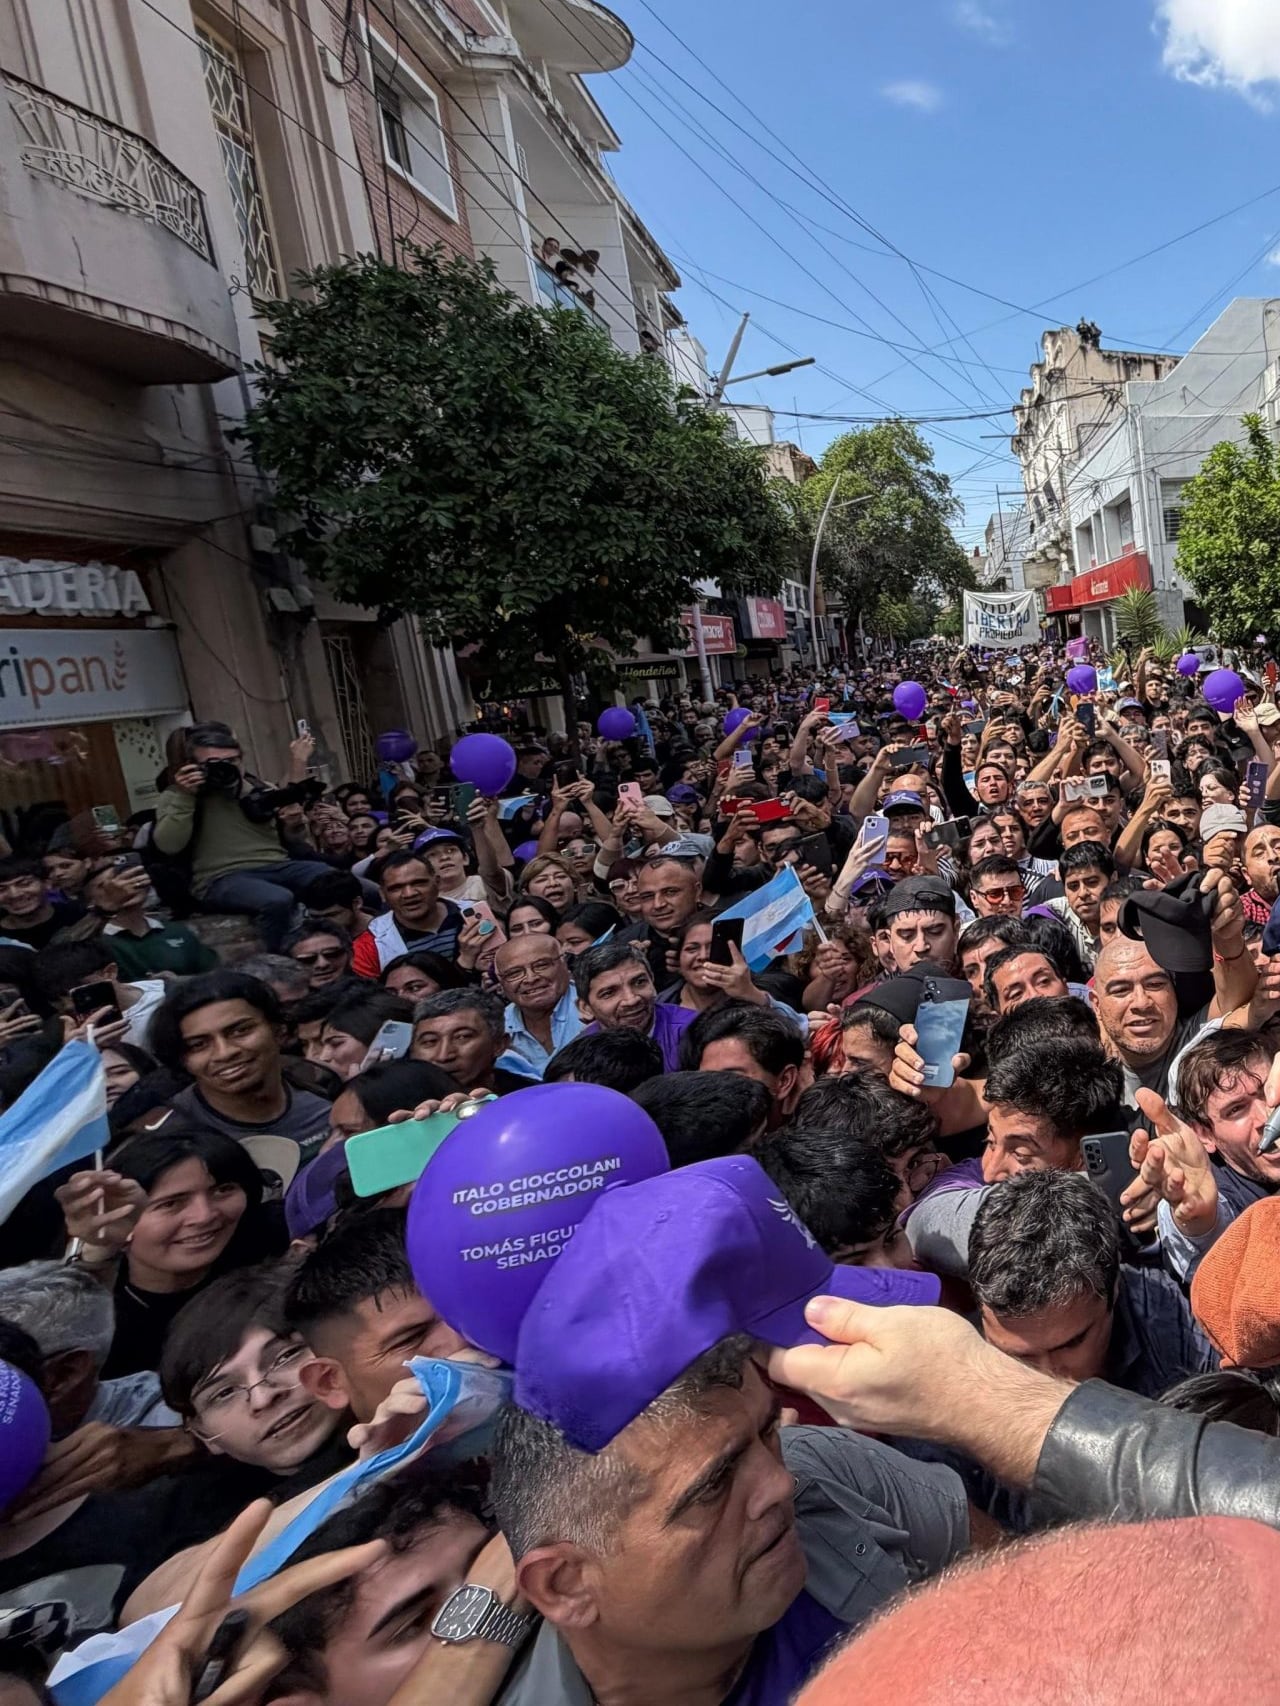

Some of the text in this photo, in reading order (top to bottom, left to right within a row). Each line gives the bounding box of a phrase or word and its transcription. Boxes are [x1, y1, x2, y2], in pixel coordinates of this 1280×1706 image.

[966, 608, 1030, 629] LIBERTAD
[980, 601, 1016, 614] VIDA
[452, 1157, 621, 1205] ITALO CIOCCOLANI
[471, 1176, 605, 1215] GOBERNADOR
[460, 1223, 579, 1262] TOMÁS FIGU
